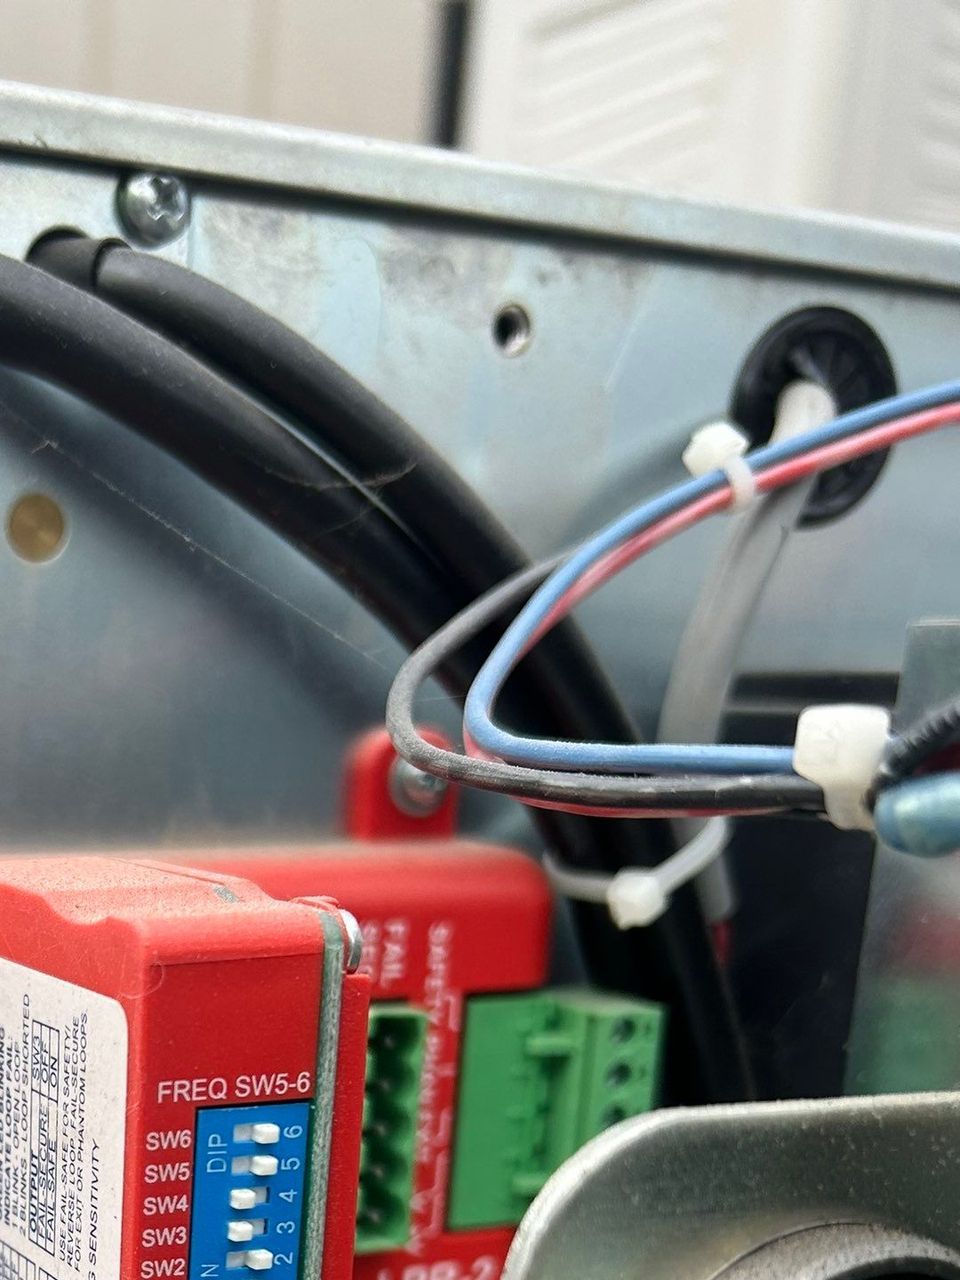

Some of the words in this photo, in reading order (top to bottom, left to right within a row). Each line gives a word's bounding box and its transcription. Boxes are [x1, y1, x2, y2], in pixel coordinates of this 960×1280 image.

[22, 994, 30, 1085] SHORTED
[32, 1035, 40, 1080] SW3
[40, 1042, 48, 1083] OFF
[49, 1057, 57, 1087] ON
[62, 1026, 71, 1097] SAFETY/
[70, 1016, 79, 1129] FAIL-SECURE
[157, 1079, 227, 1103] FREQ
[235, 1072, 311, 1097] SW5-6
[77, 1077, 85, 1162] PHANTOM
[285, 1124, 303, 1139] 6
[145, 1131, 191, 1150] SW6
[207, 1133, 227, 1174] DIP
[37, 1104, 47, 1238] FAIL-SECURE
[76, 1168, 83, 1193] OR
[144, 1163, 190, 1182] SW5
[281, 1158, 300, 1172] 5
[19, 1157, 27, 1221] BLINKS
[29, 1150, 38, 1233] OUTPUT
[46, 1139, 55, 1242] FAIL-SAFE
[60, 1143, 68, 1224] FAIL-SAFE
[278, 1188, 297, 1203] 4
[88, 1139, 99, 1265] SENSITIVITY
[143, 1194, 189, 1215] SW4
[141, 1227, 187, 1247] SW3
[276, 1220, 294, 1235] 3
[140, 1259, 185, 1279] SW2
[275, 1252, 293, 1265] 2
